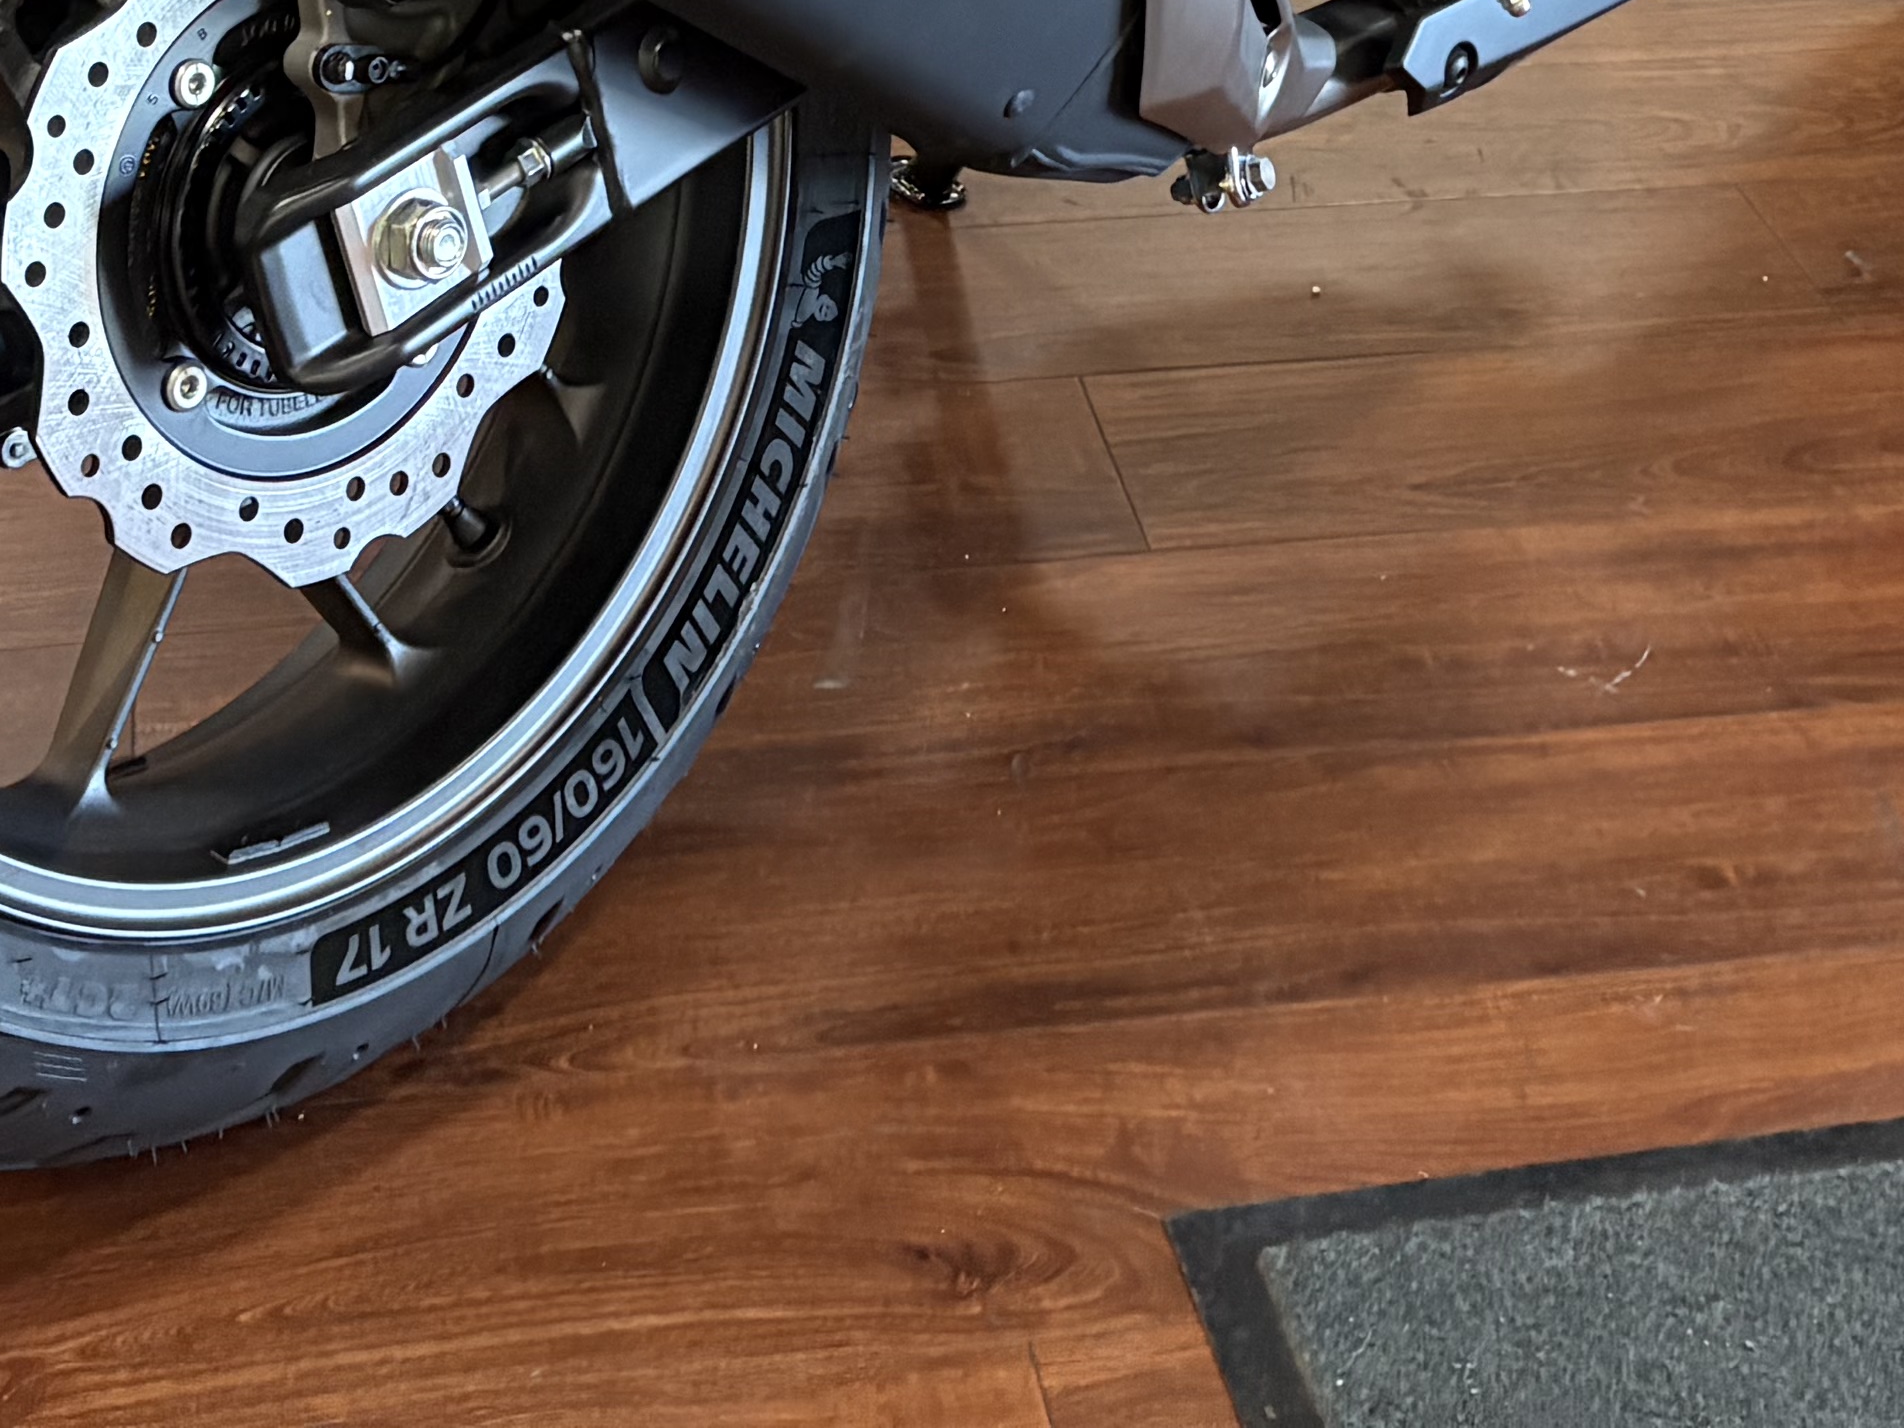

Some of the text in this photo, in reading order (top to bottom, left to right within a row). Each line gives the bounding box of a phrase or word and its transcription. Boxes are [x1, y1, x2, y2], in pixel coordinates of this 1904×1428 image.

[215, 389, 253, 417] FOR
[334, 344, 829, 989] MICHELIN 160/60 ZR 17
